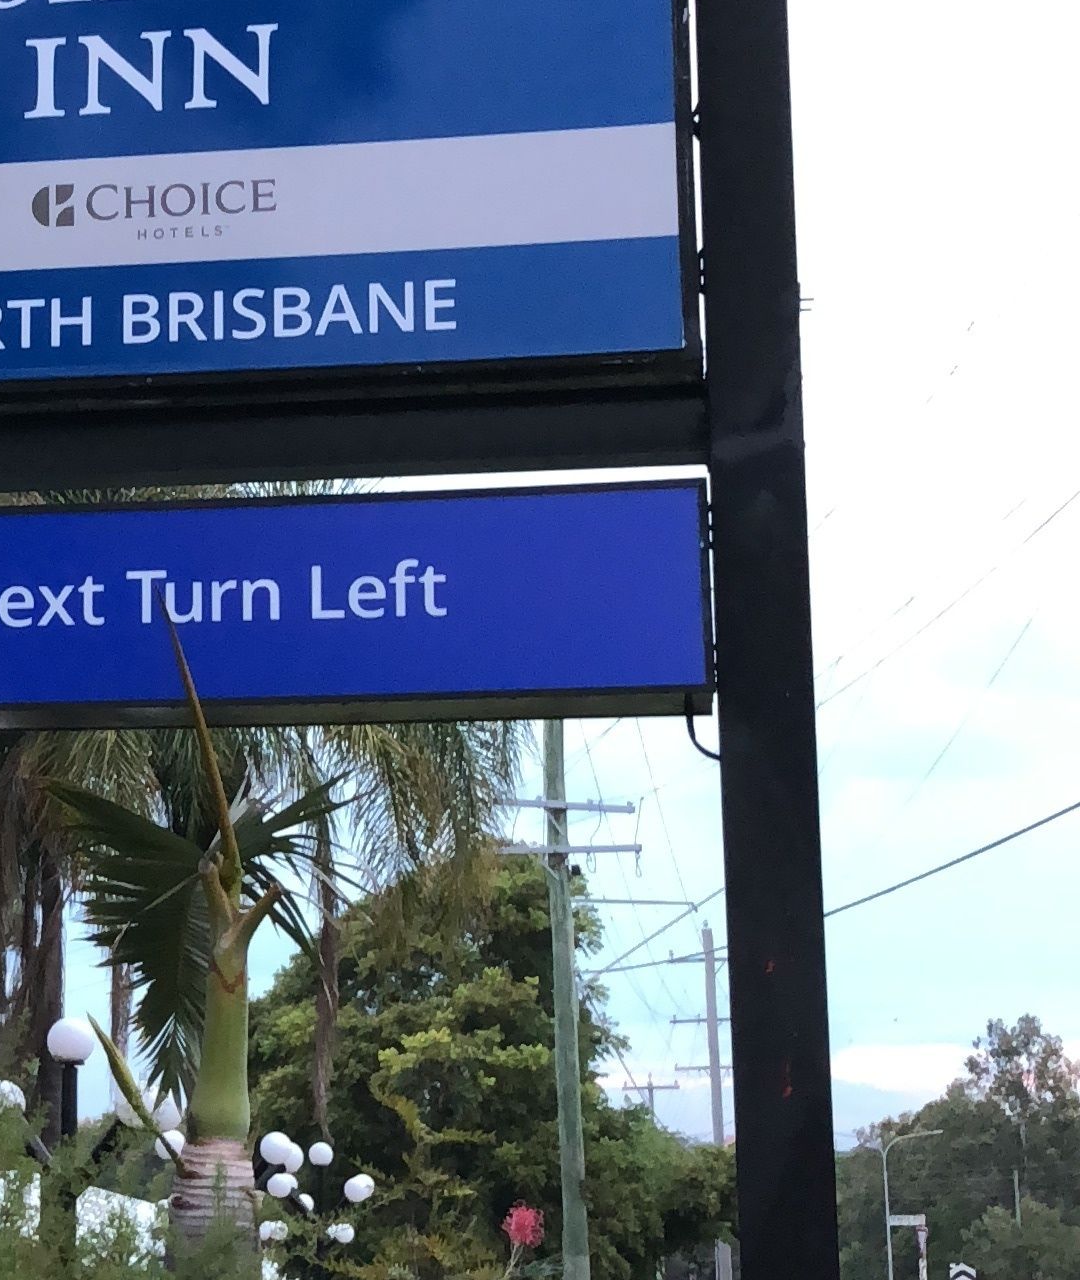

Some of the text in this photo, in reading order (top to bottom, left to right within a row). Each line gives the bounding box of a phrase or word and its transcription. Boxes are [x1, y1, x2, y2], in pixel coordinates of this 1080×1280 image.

[24, 23, 279, 119] INN
[85, 177, 279, 222] CHOICE
[136, 223, 224, 241] HOTELS
[122, 278, 458, 345] BRISBANE
[125, 570, 281, 624] Turn
[310, 558, 448, 620] Left
